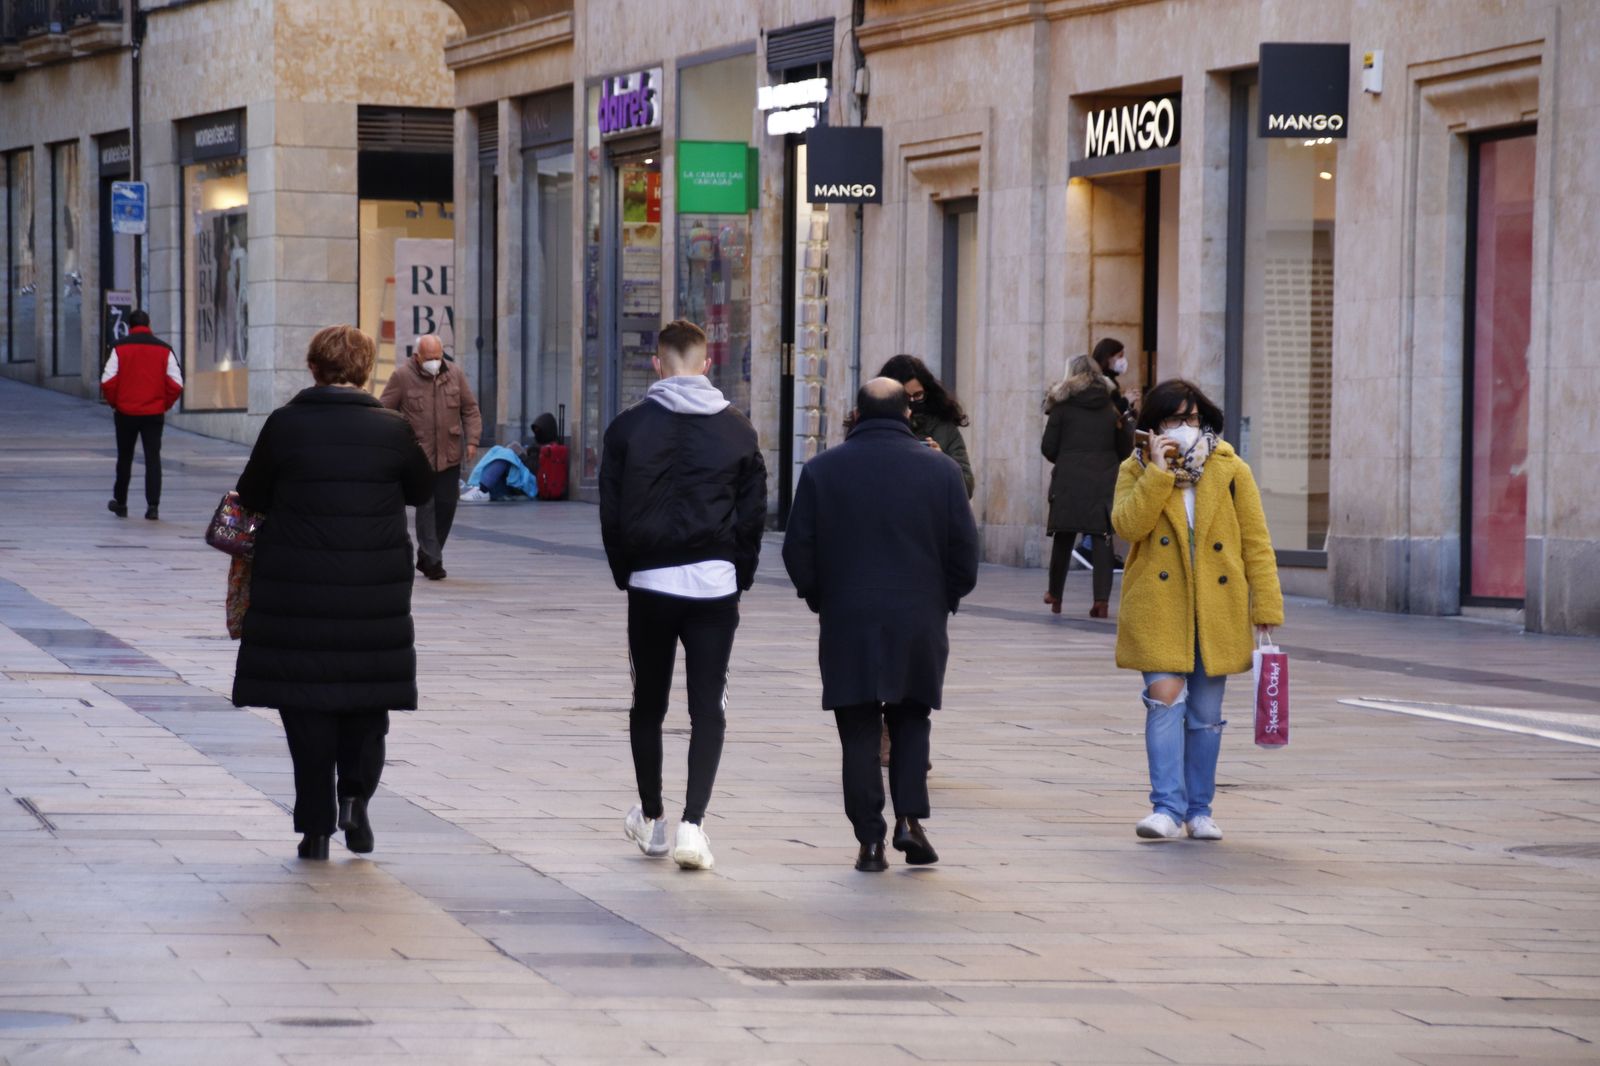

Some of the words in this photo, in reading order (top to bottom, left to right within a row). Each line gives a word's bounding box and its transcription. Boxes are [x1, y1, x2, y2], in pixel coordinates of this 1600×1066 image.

[1084, 98, 1175, 159] MANGO
[1268, 113, 1344, 131] MANGO
[814, 184, 876, 197] MANGO
